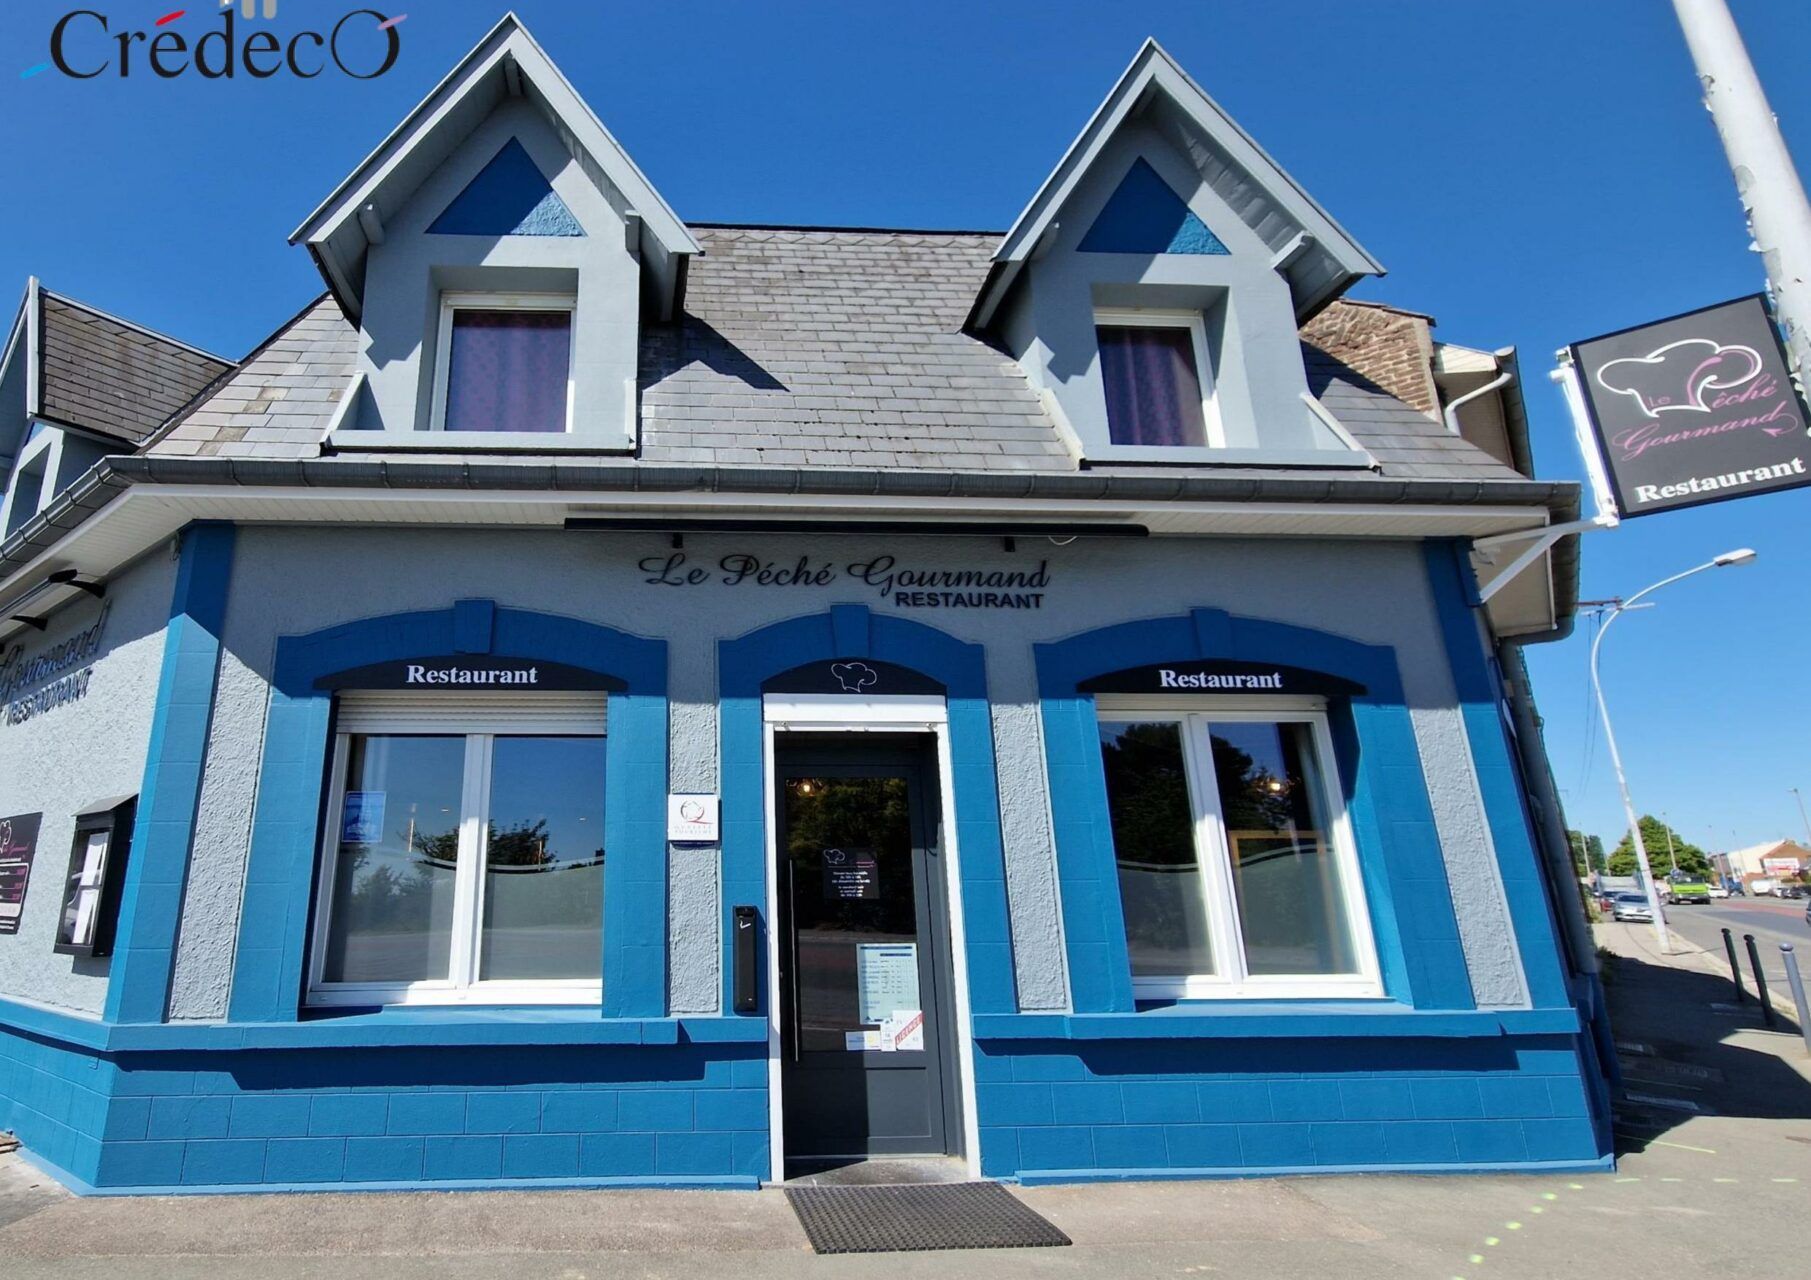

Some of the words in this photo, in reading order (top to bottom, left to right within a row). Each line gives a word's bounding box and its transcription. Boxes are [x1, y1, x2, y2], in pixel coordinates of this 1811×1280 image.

[1611, 399, 1799, 462] Gourmand
[1634, 456, 1807, 504] Restaurant
[638, 552, 710, 587] Le
[719, 552, 837, 587] Péché
[847, 555, 1052, 597] Gourmand
[895, 591, 1045, 610] RESTAURANT
[405, 664, 539, 685] Restaurant
[1158, 669, 1283, 689] Restaurant
